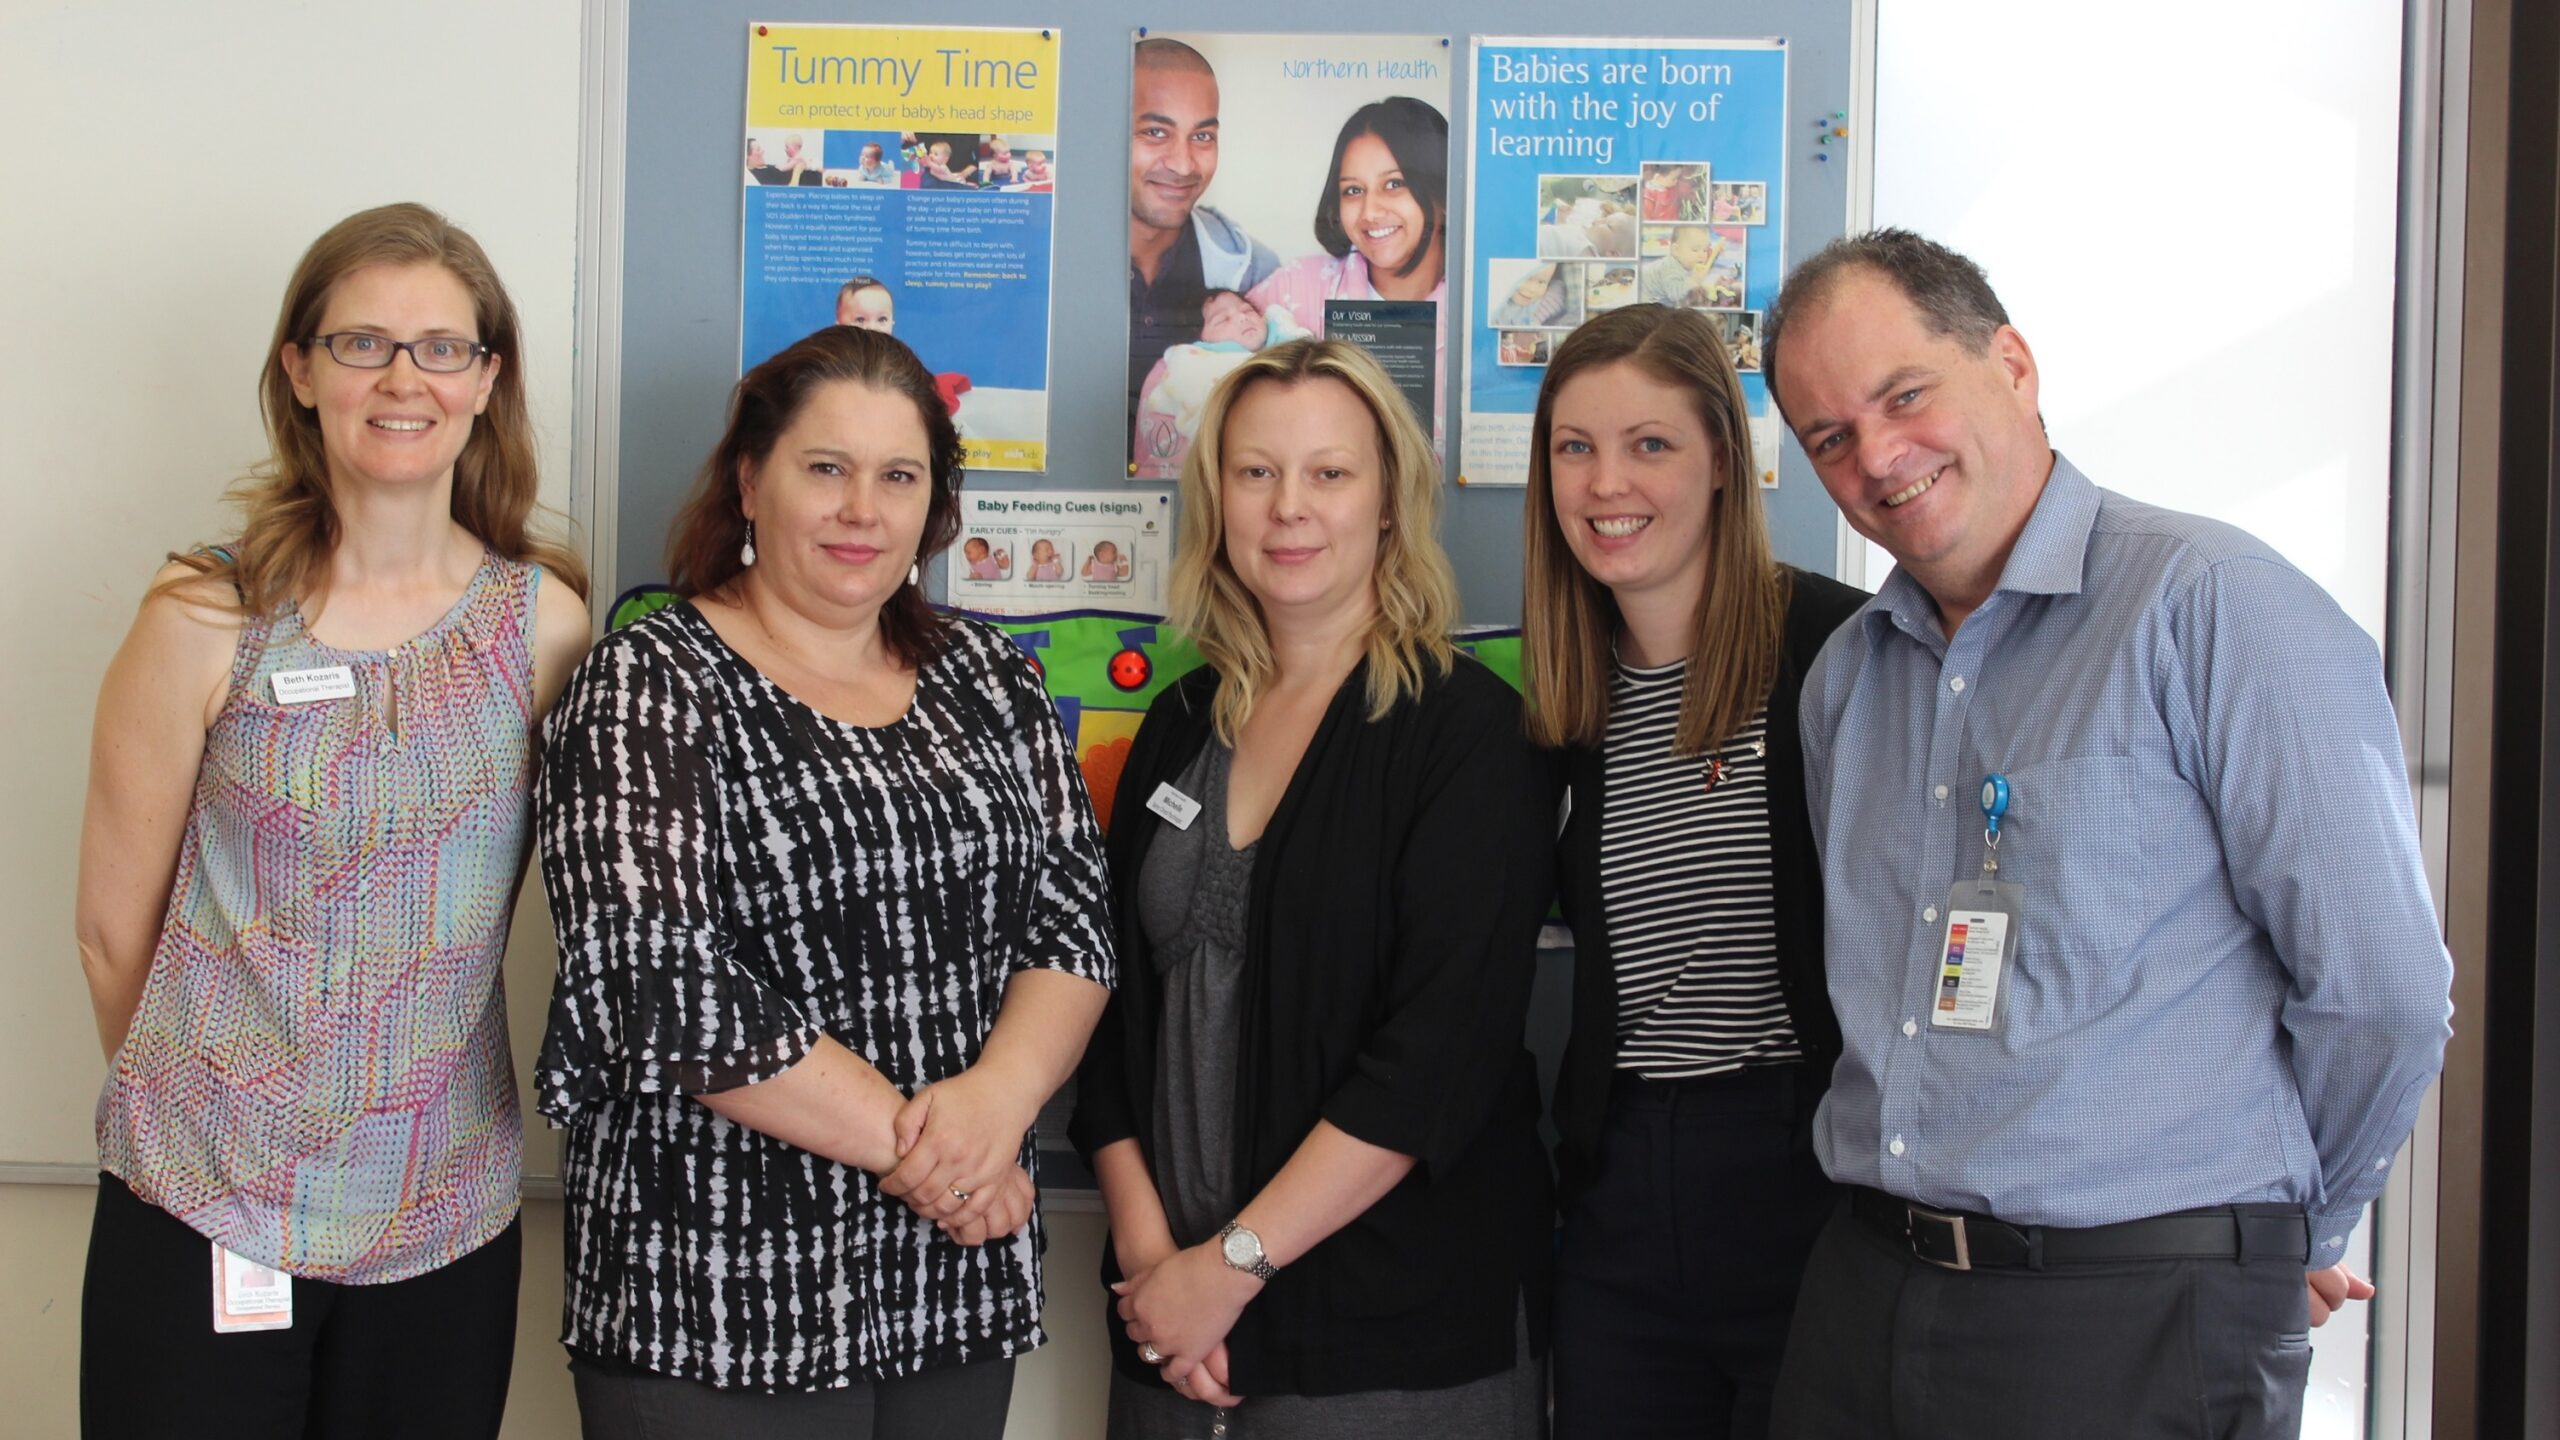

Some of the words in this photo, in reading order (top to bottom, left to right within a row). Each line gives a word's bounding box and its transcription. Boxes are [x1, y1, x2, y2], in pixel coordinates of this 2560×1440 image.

[772, 46, 922, 97] Tummy
[936, 48, 1038, 90] Time
[1282, 59, 1368, 79] Northern
[1377, 59, 1438, 80] Health
[1491, 54, 1590, 85] Babies
[1601, 63, 1647, 85] are
[1660, 56, 1732, 85] born
[778, 104, 804, 116] can
[808, 104, 861, 119] protect
[865, 107, 897, 120] your
[901, 104, 946, 122] baby's
[949, 105, 986, 121] head
[990, 106, 1034, 124] shape
[1490, 91, 1557, 120] with
[1571, 92, 1619, 121] the
[1625, 92, 1677, 129] joy
[1689, 92, 1724, 122] of
[1490, 128, 1614, 165] learning
[967, 206, 983, 215] baby
[977, 500, 1009, 514] Baby
[1012, 500, 1061, 514] Feeding
[1065, 501, 1096, 512] Cues
[1099, 502, 1142, 515] (signs)
[306, 672, 340, 682] Kozaris
